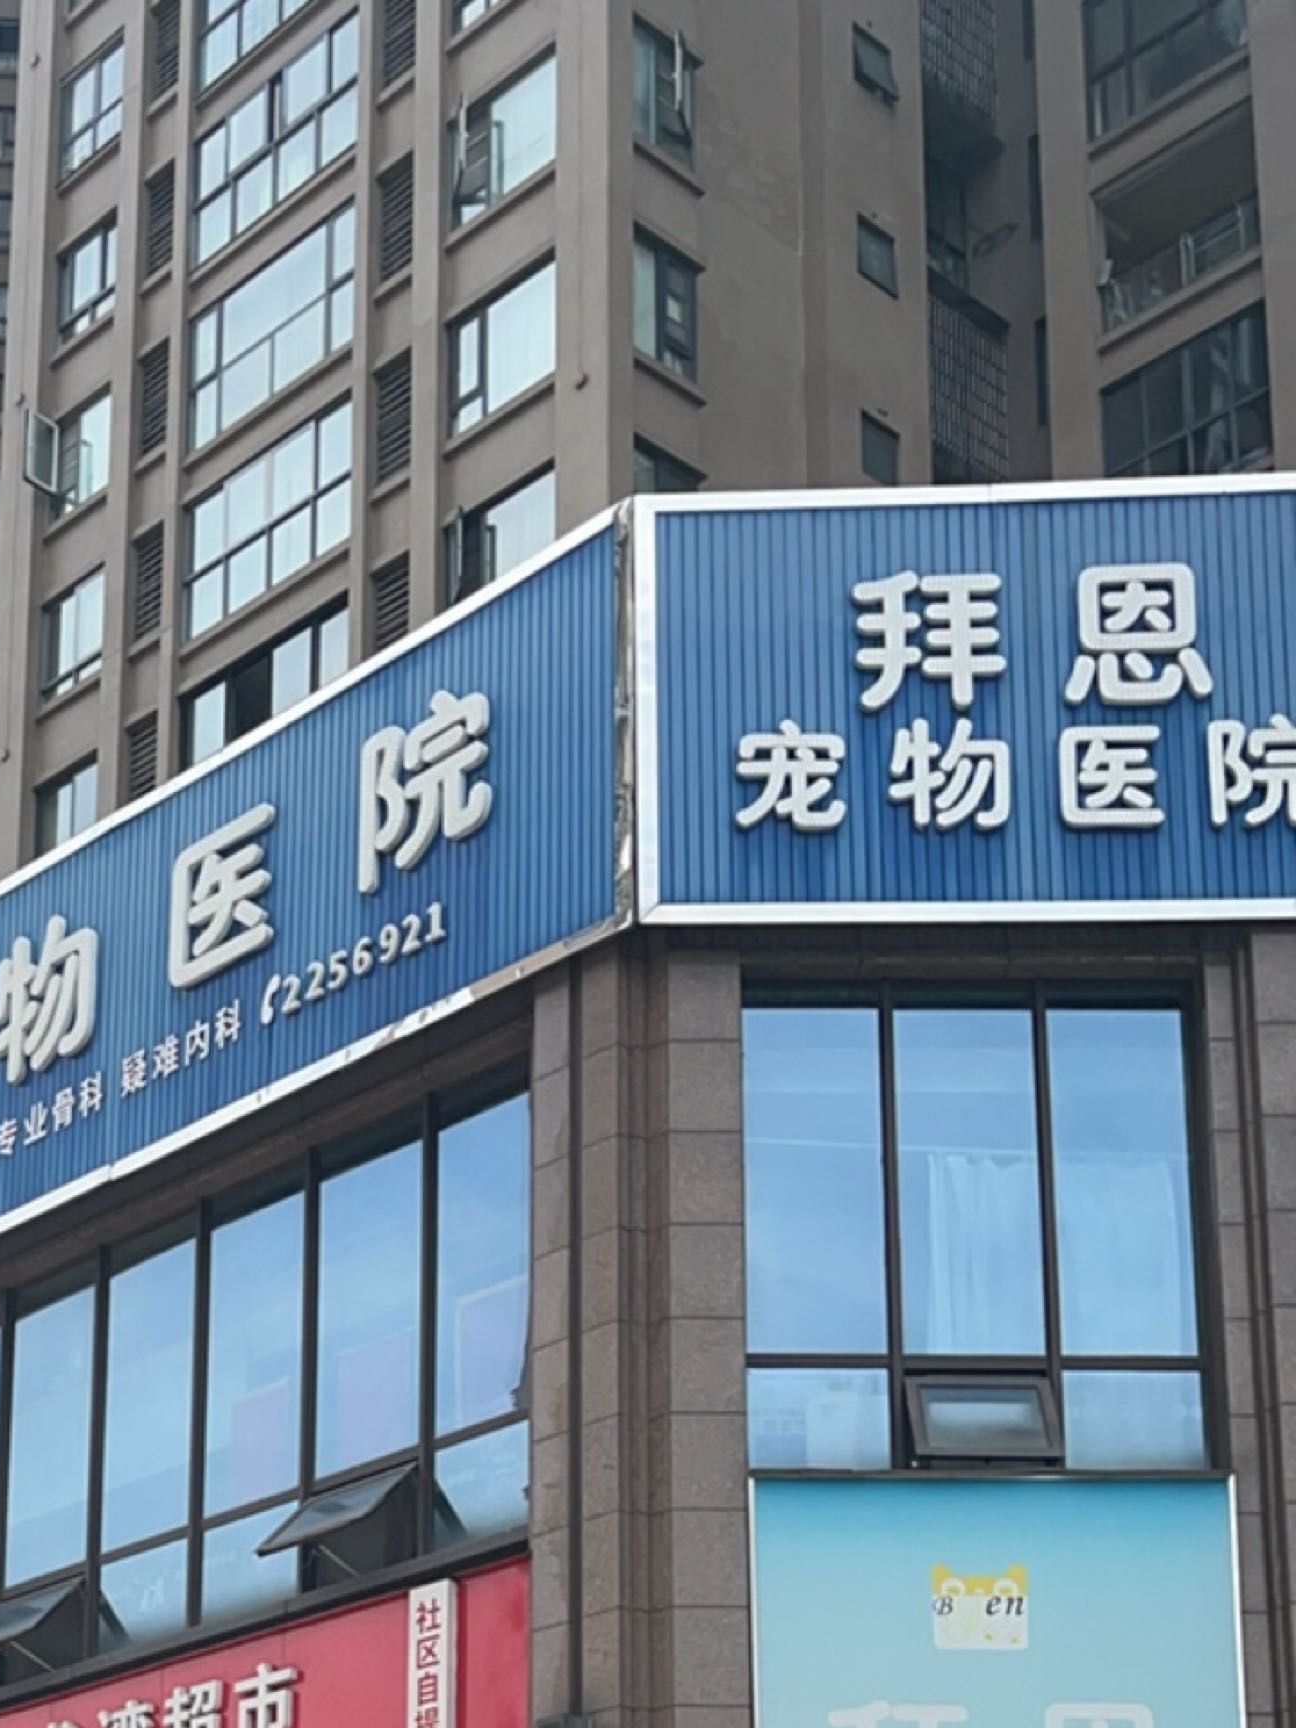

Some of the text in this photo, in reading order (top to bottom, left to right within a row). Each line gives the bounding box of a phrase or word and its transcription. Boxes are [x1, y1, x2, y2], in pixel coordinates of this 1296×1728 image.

[852, 562, 1214, 712] 拜恩
[734, 713, 1296, 832] 宠物医院
[120, 1002, 242, 1099] 疑难内科
[278, 902, 448, 1018] 2256921
